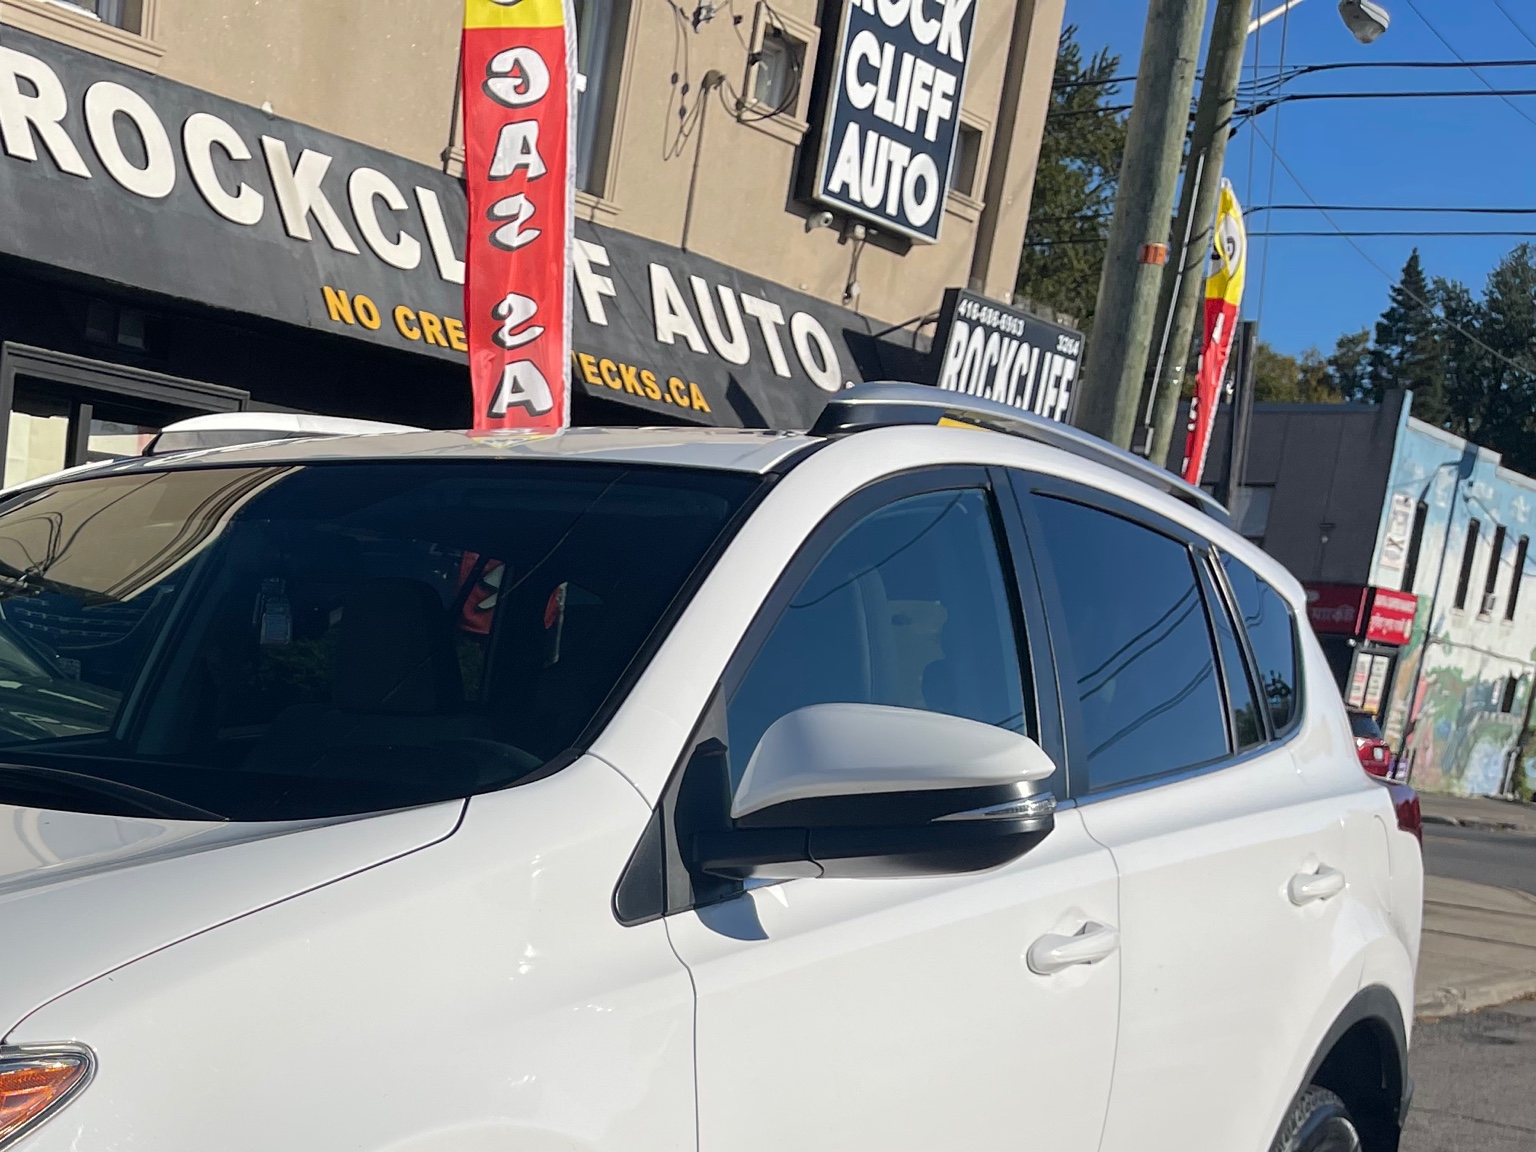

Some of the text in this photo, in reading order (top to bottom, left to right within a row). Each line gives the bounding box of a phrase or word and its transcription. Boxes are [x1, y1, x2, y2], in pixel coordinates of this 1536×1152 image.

[859, 0, 971, 62] CK
[846, 30, 957, 142] CLIFF
[827, 121, 939, 227] AUTO
[322, 285, 382, 330] NO
[573, 349, 712, 414] ECKS.CA
[649, 262, 843, 393] AUTO
[940, 319, 1077, 423] ROCKCLIFF
